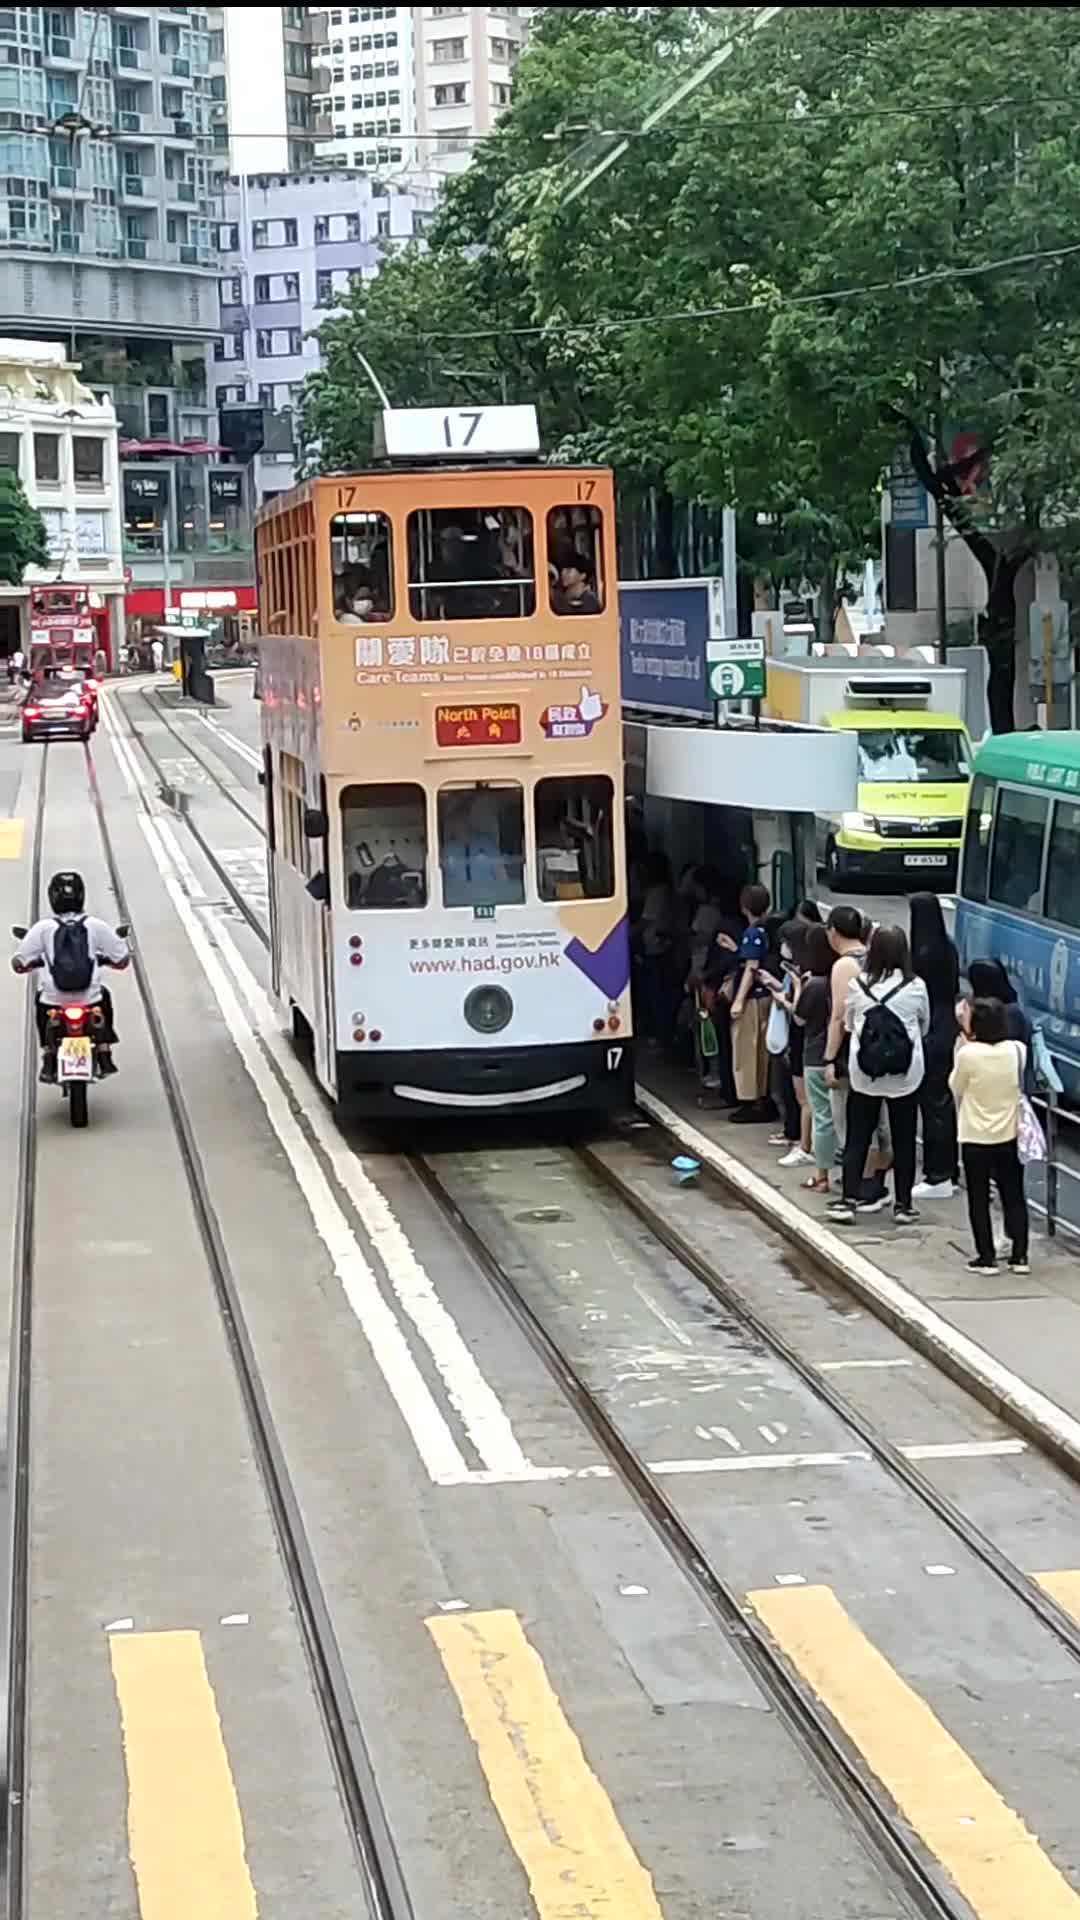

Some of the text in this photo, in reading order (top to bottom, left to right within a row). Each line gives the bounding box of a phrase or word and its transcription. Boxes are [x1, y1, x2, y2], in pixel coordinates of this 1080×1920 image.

[443, 412, 483, 448] 17
[338, 487, 357, 508] 17
[577, 480, 596, 501] 17
[356, 671, 391, 684] Care
[394, 669, 441, 683] Teams
[437, 705, 517, 722] North Point
[409, 951, 561, 974] www.had.gov.hk
[607, 1046, 623, 1070] 17
